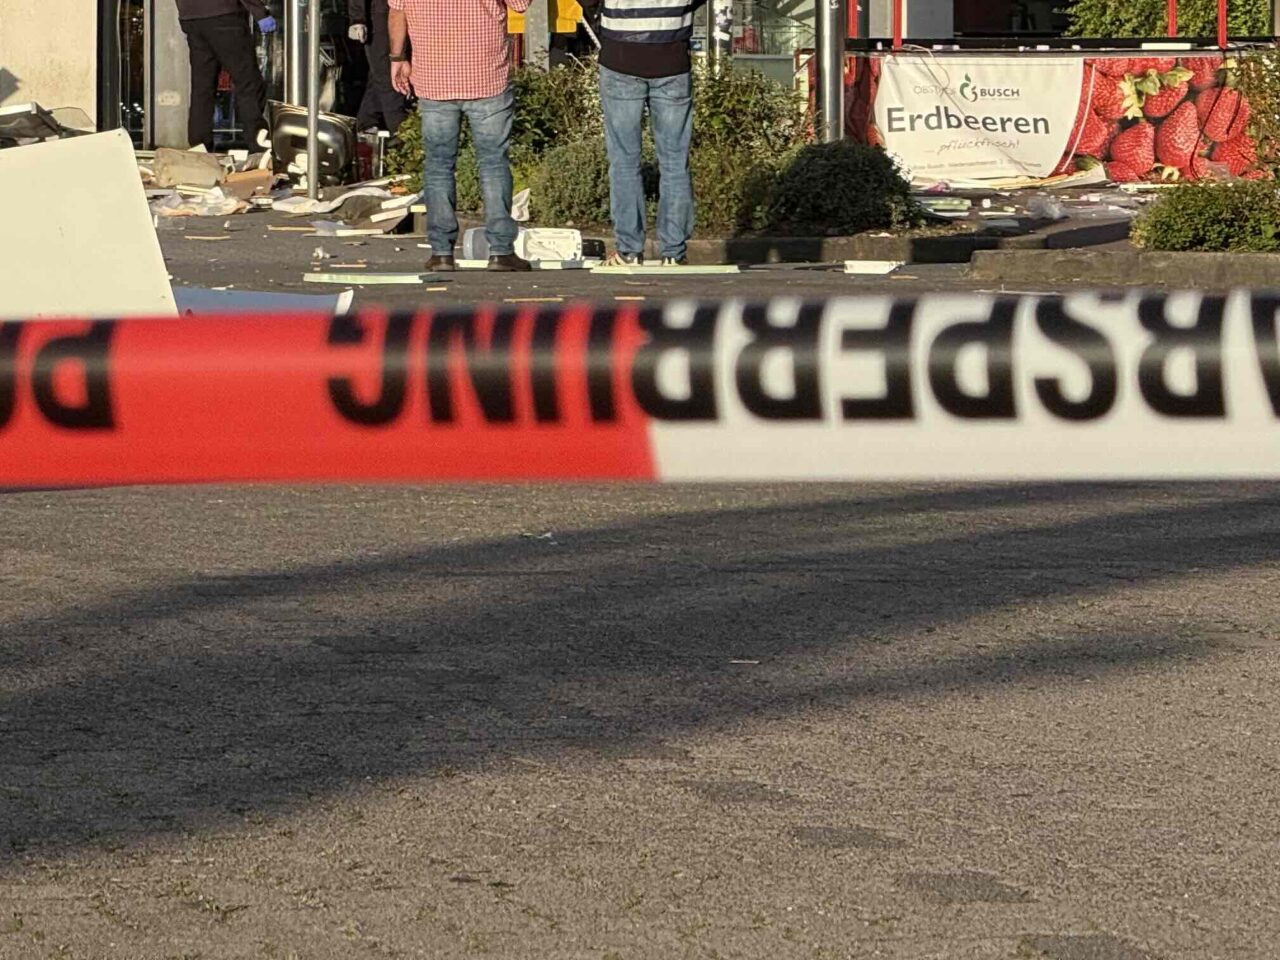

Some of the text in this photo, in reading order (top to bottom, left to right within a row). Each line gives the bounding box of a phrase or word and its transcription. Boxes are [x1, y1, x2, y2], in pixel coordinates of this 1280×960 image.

[980, 88, 1020, 97] BUSCH
[887, 105, 1050, 134] Erdbeeren
[327, 294, 1280, 427] BSPERRUNG
